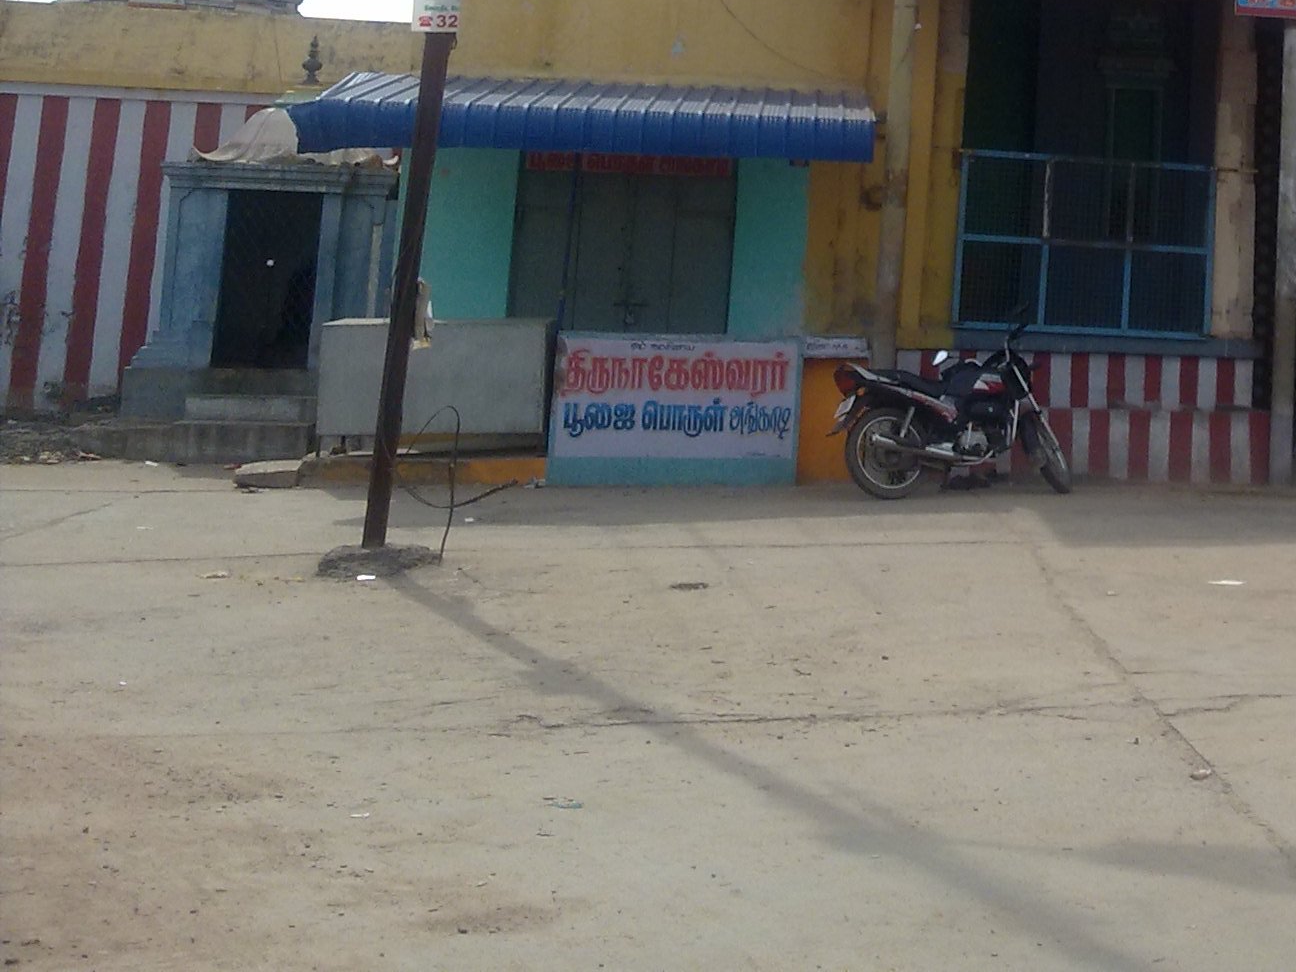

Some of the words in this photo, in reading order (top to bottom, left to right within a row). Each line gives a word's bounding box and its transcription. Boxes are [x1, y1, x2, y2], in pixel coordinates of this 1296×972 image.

[563, 401, 636, 438] பூஜை
[641, 397, 729, 438] பொருள்
[729, 401, 792, 440] அங்காடி
